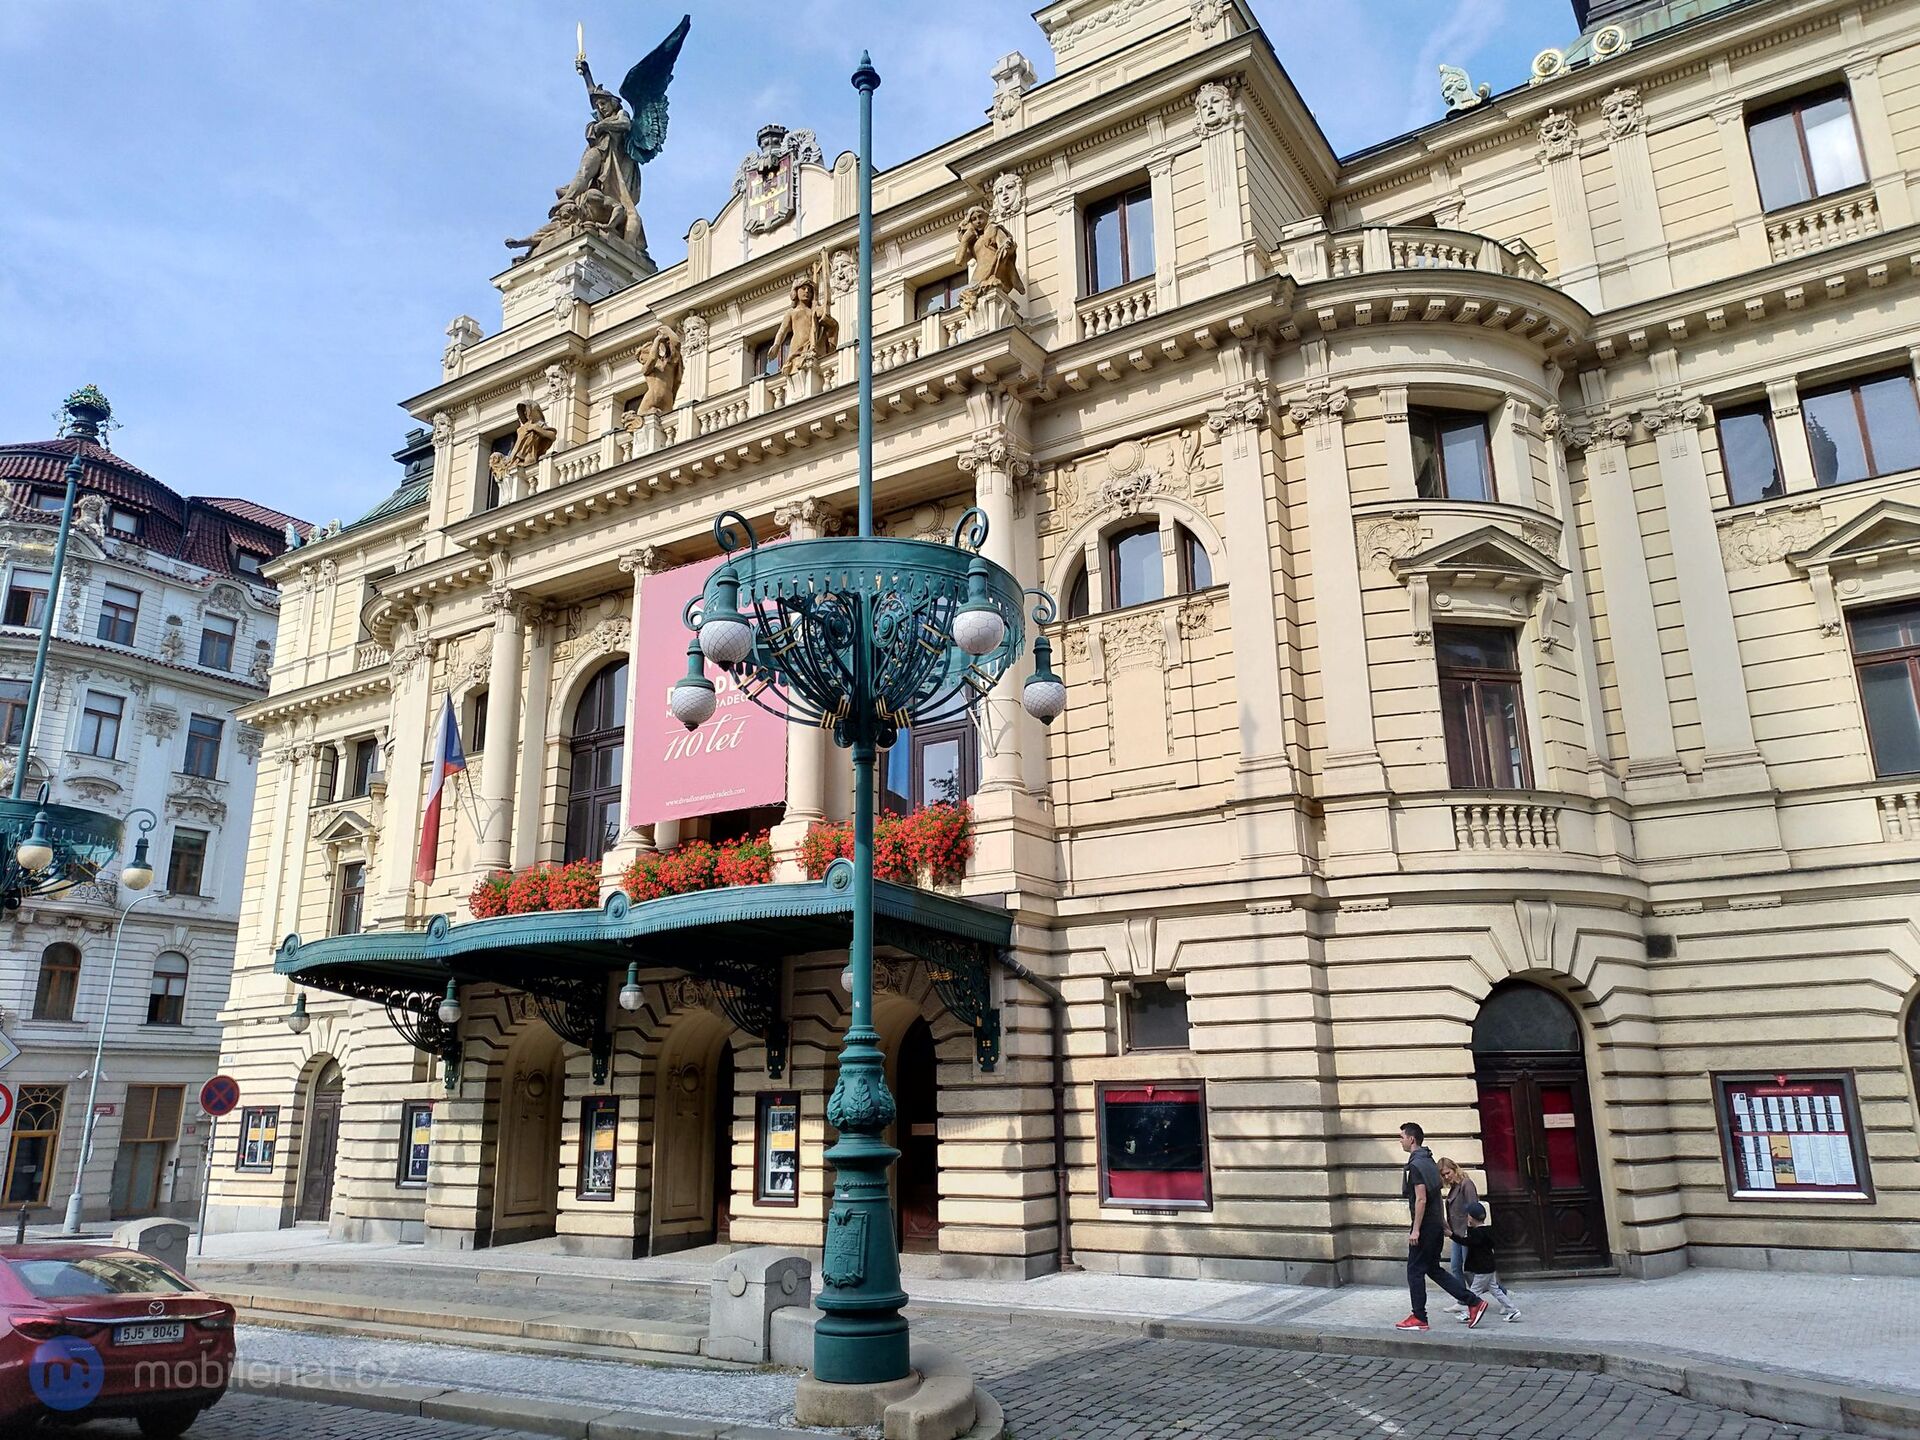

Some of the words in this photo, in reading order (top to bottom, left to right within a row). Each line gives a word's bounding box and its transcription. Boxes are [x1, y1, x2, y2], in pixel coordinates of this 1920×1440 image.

[664, 731, 703, 761] 110
[705, 714, 746, 753] let
[123, 1327, 145, 1340] 5J5
[153, 1325, 179, 1338] 8045
